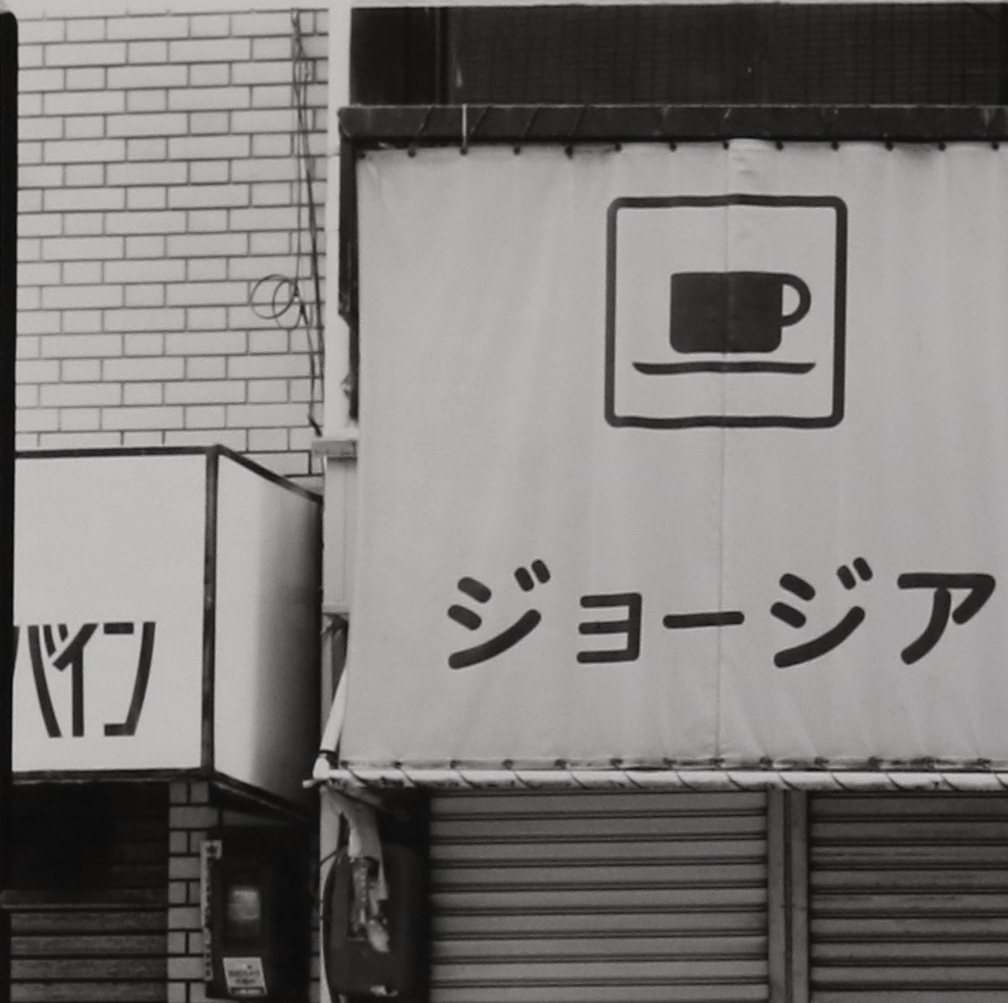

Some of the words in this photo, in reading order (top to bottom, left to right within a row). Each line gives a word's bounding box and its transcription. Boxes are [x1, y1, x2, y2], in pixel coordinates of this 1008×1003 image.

[447, 556, 997, 670] ジョージア
